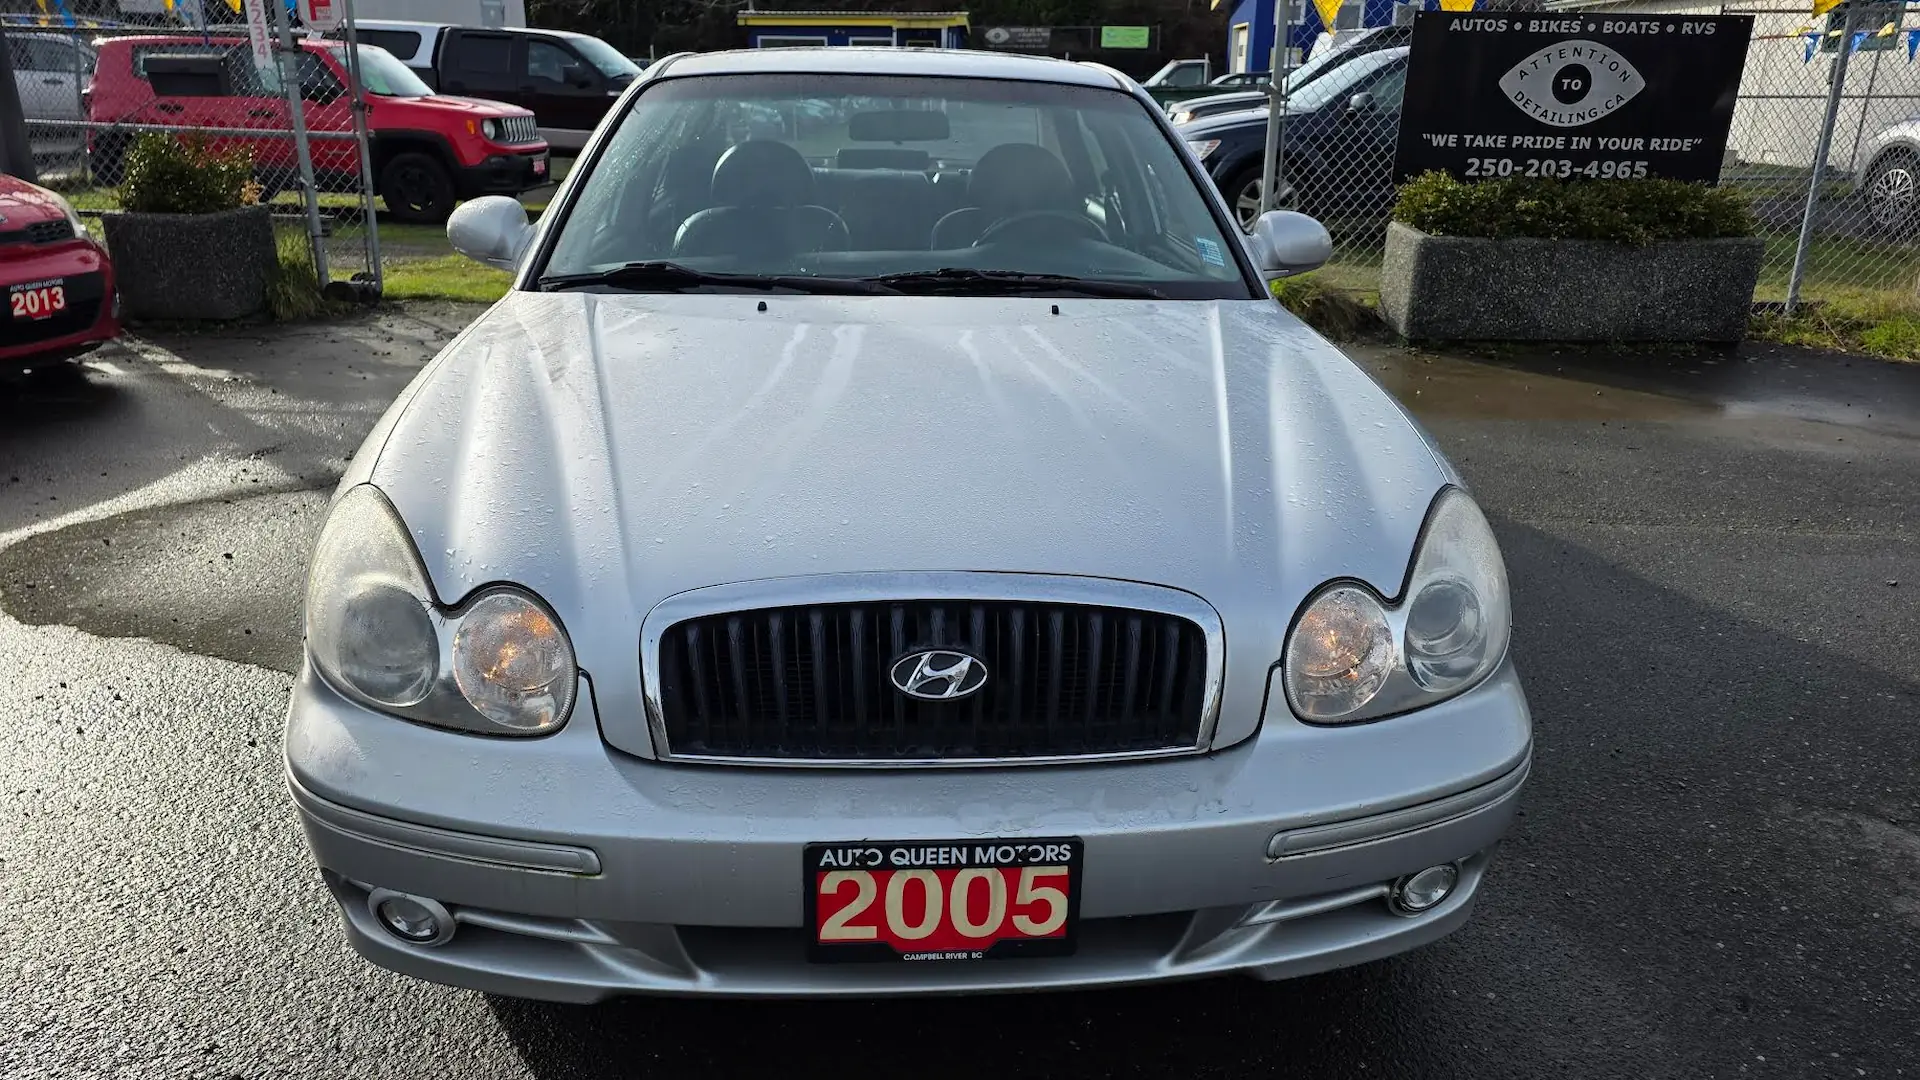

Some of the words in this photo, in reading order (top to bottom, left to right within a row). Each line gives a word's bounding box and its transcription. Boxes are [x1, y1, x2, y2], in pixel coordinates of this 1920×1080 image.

[1449, 18, 1508, 32] AUTOS
[1528, 20, 1581, 33] BIKES
[1602, 21, 1660, 35] BOATS
[1681, 22, 1717, 35] RVS
[1518, 47, 1631, 83] ATTENTION
[1561, 78, 1583, 91] TO
[1513, 90, 1626, 124] DETAILING.CA
[1463, 134, 1507, 148] TAKE
[1511, 135, 1565, 149] PRIDE
[1570, 137, 1592, 150] IN
[1598, 137, 1644, 151] YOUR
[1464, 158, 1649, 180] 250-203-4965
[11, 286, 65, 316] 2013
[819, 848, 883, 867] AUTO
[890, 847, 967, 865] QUEEN
[975, 844, 1072, 864] MOTORS
[819, 865, 1069, 940] 2005
[903, 952, 944, 961] CAMPBELL
[945, 952, 968, 960] RIVER
